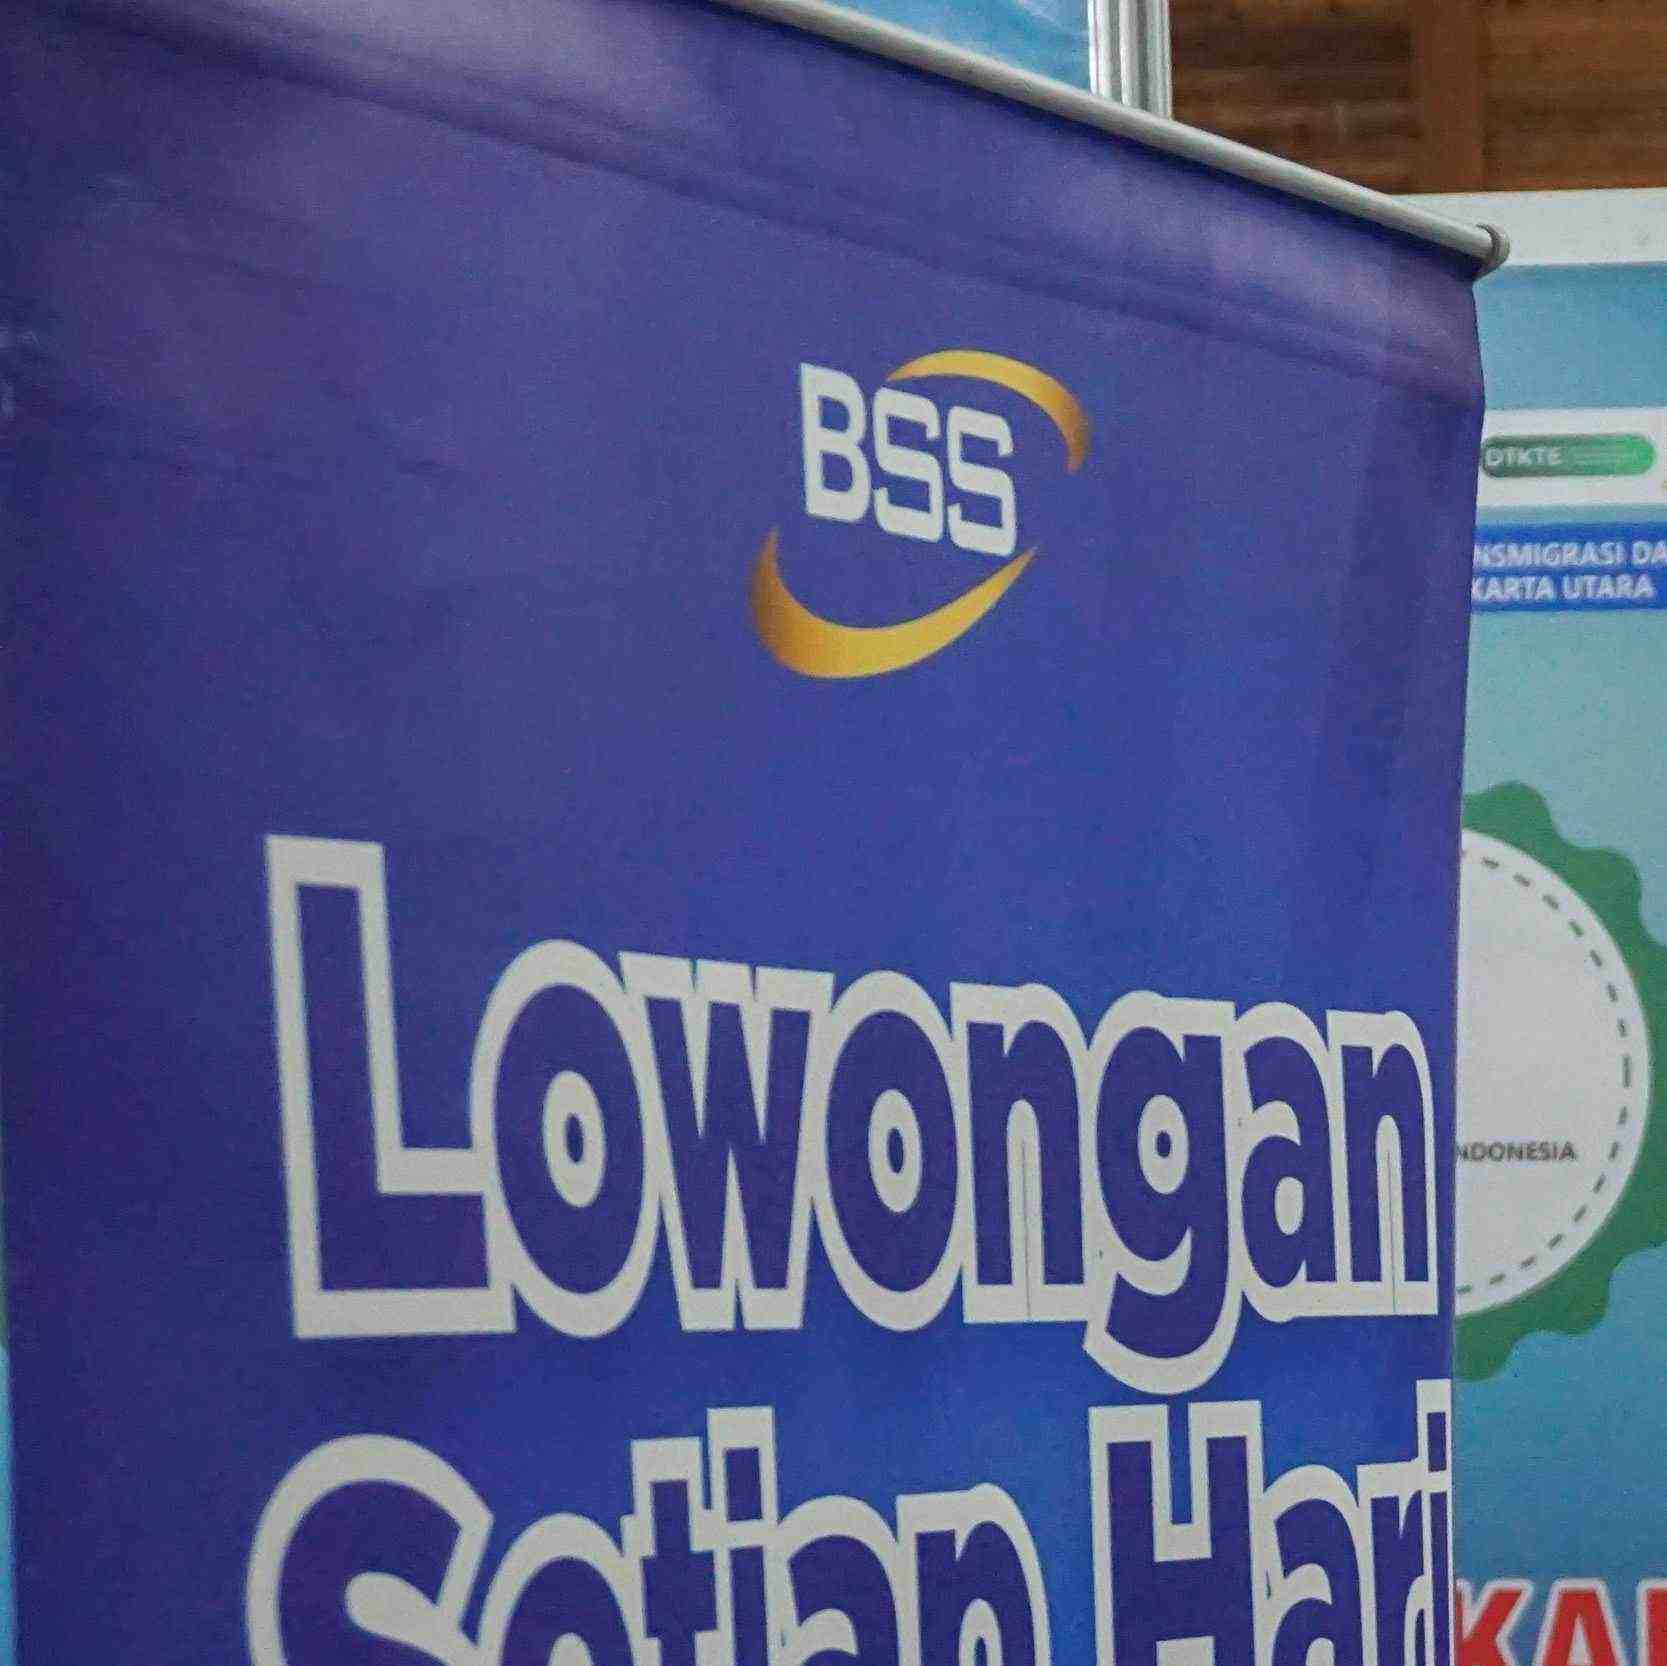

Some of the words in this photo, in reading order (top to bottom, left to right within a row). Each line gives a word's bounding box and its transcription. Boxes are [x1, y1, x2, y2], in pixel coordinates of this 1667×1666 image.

[799, 363, 1017, 557] BSS
[1563, 574, 1656, 599] UTARA
[265, 834, 1438, 1394] Lowongan
